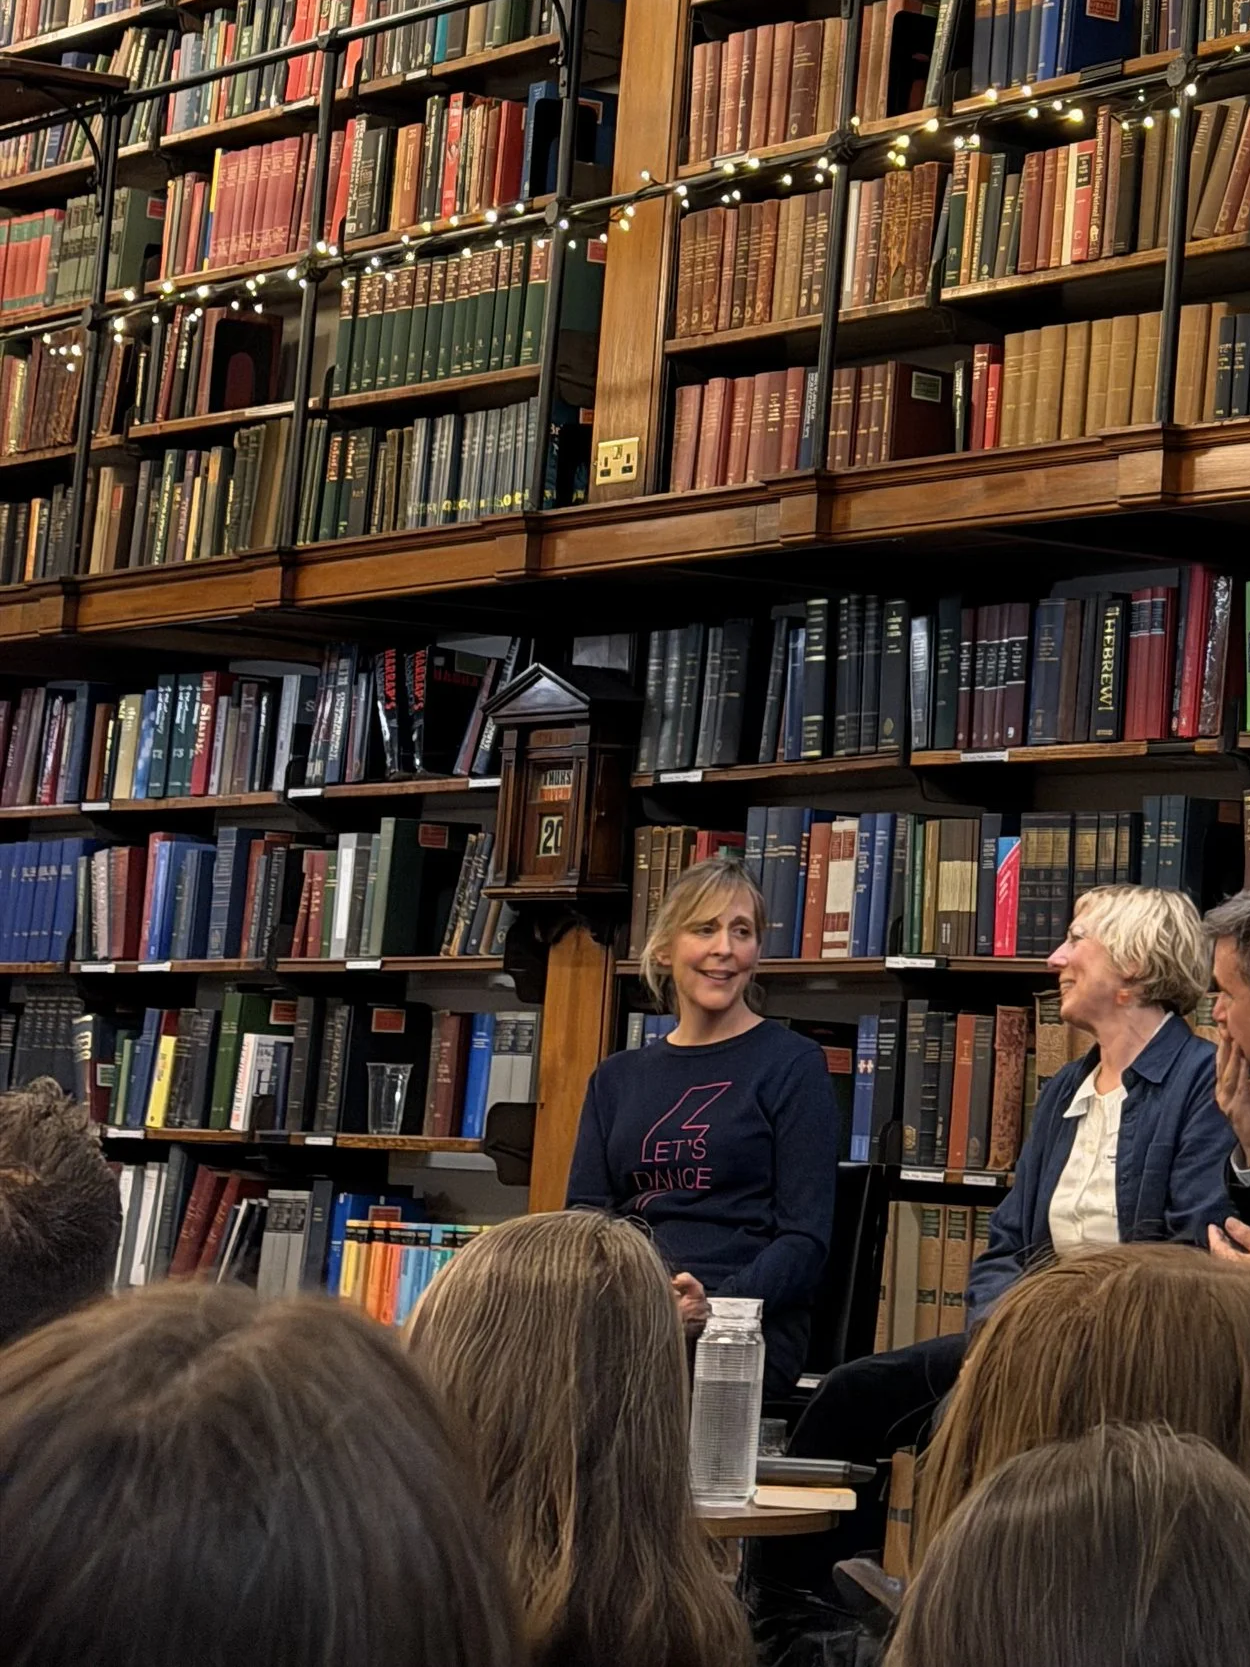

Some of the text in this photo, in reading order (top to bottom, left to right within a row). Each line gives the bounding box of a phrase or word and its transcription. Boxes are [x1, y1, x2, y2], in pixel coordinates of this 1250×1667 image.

[384, 649, 397, 710] HARRAP'S
[412, 649, 427, 711] HARRAP'S
[1099, 618, 1117, 705] HEBREW
[633, 1167, 713, 1191] DANCE
